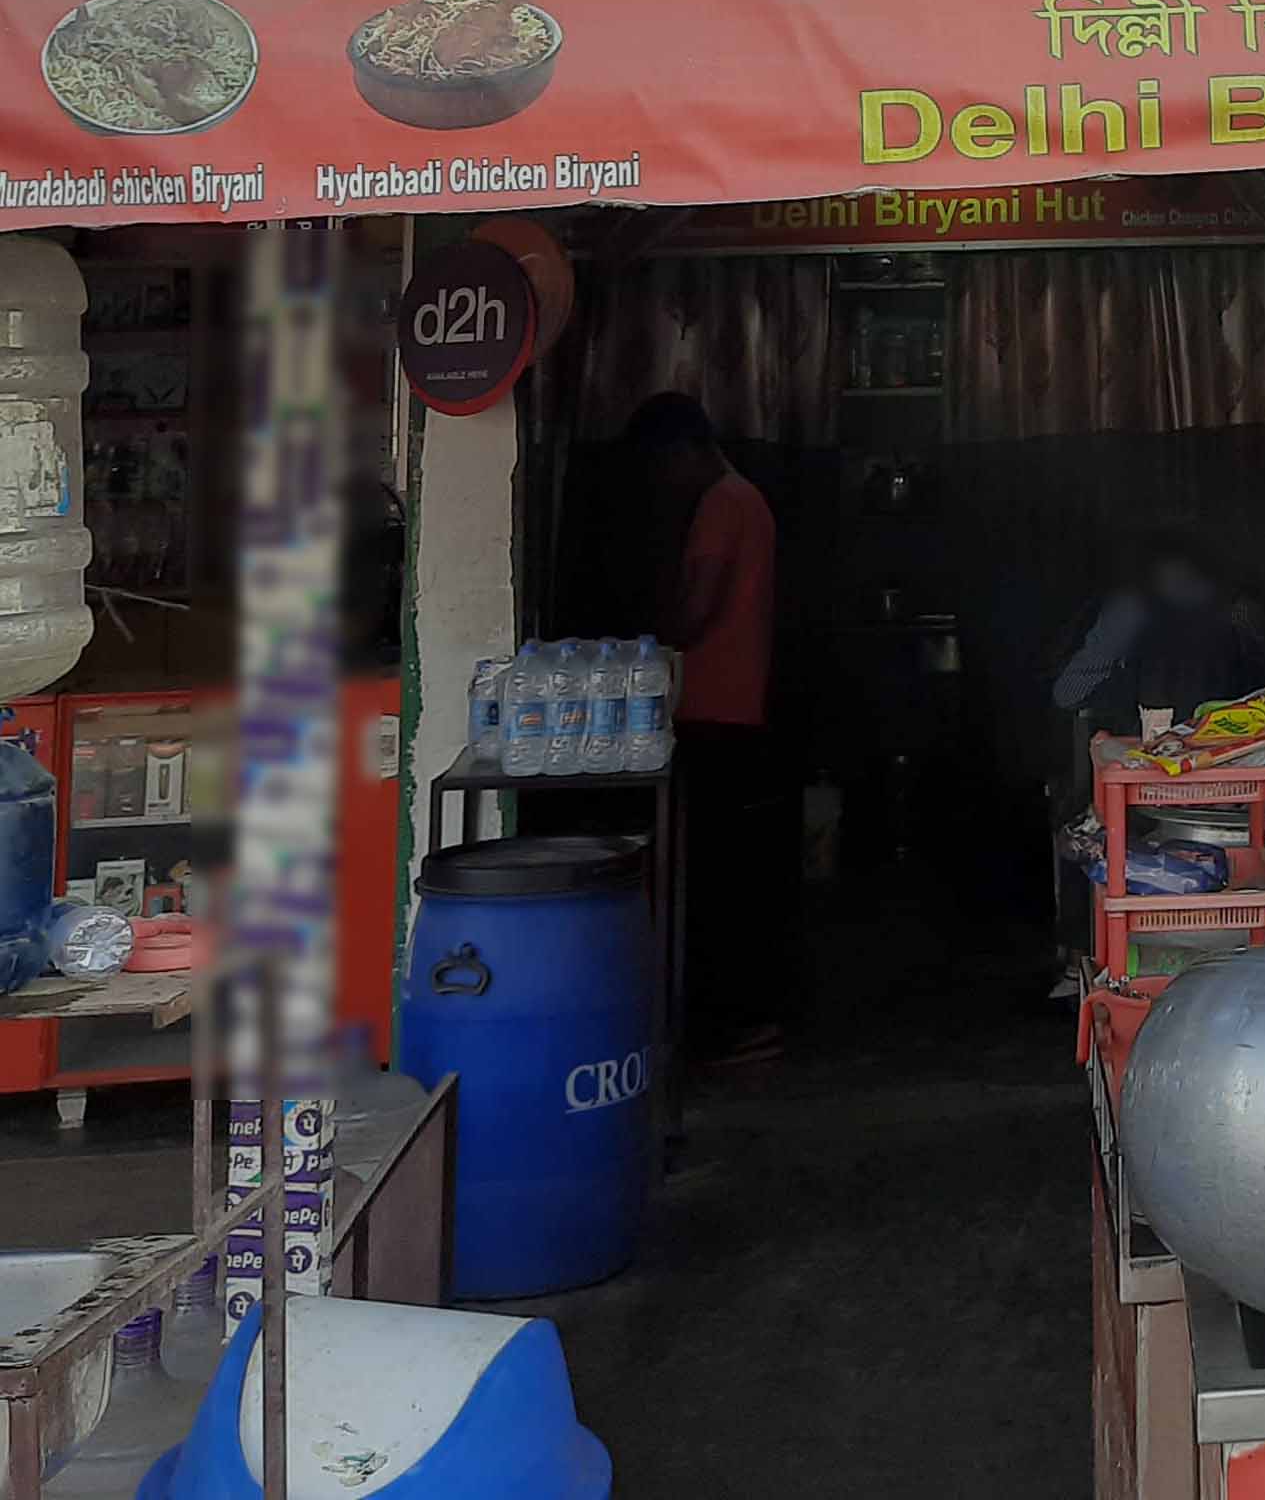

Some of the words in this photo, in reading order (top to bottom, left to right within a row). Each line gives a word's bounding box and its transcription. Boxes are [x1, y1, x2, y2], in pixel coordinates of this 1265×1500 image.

[860, 77, 1162, 166] Delhi
[112, 165, 186, 205] chicken
[191, 163, 265, 213] Biryani
[316, 159, 442, 207] Hydrabadi
[447, 154, 549, 194] Chicken
[554, 152, 640, 200] Biryani
[753, 196, 859, 228] Delhi
[875, 188, 1020, 234] Biryani
[1035, 187, 1105, 224] Hut
[414, 287, 506, 345] d2h
